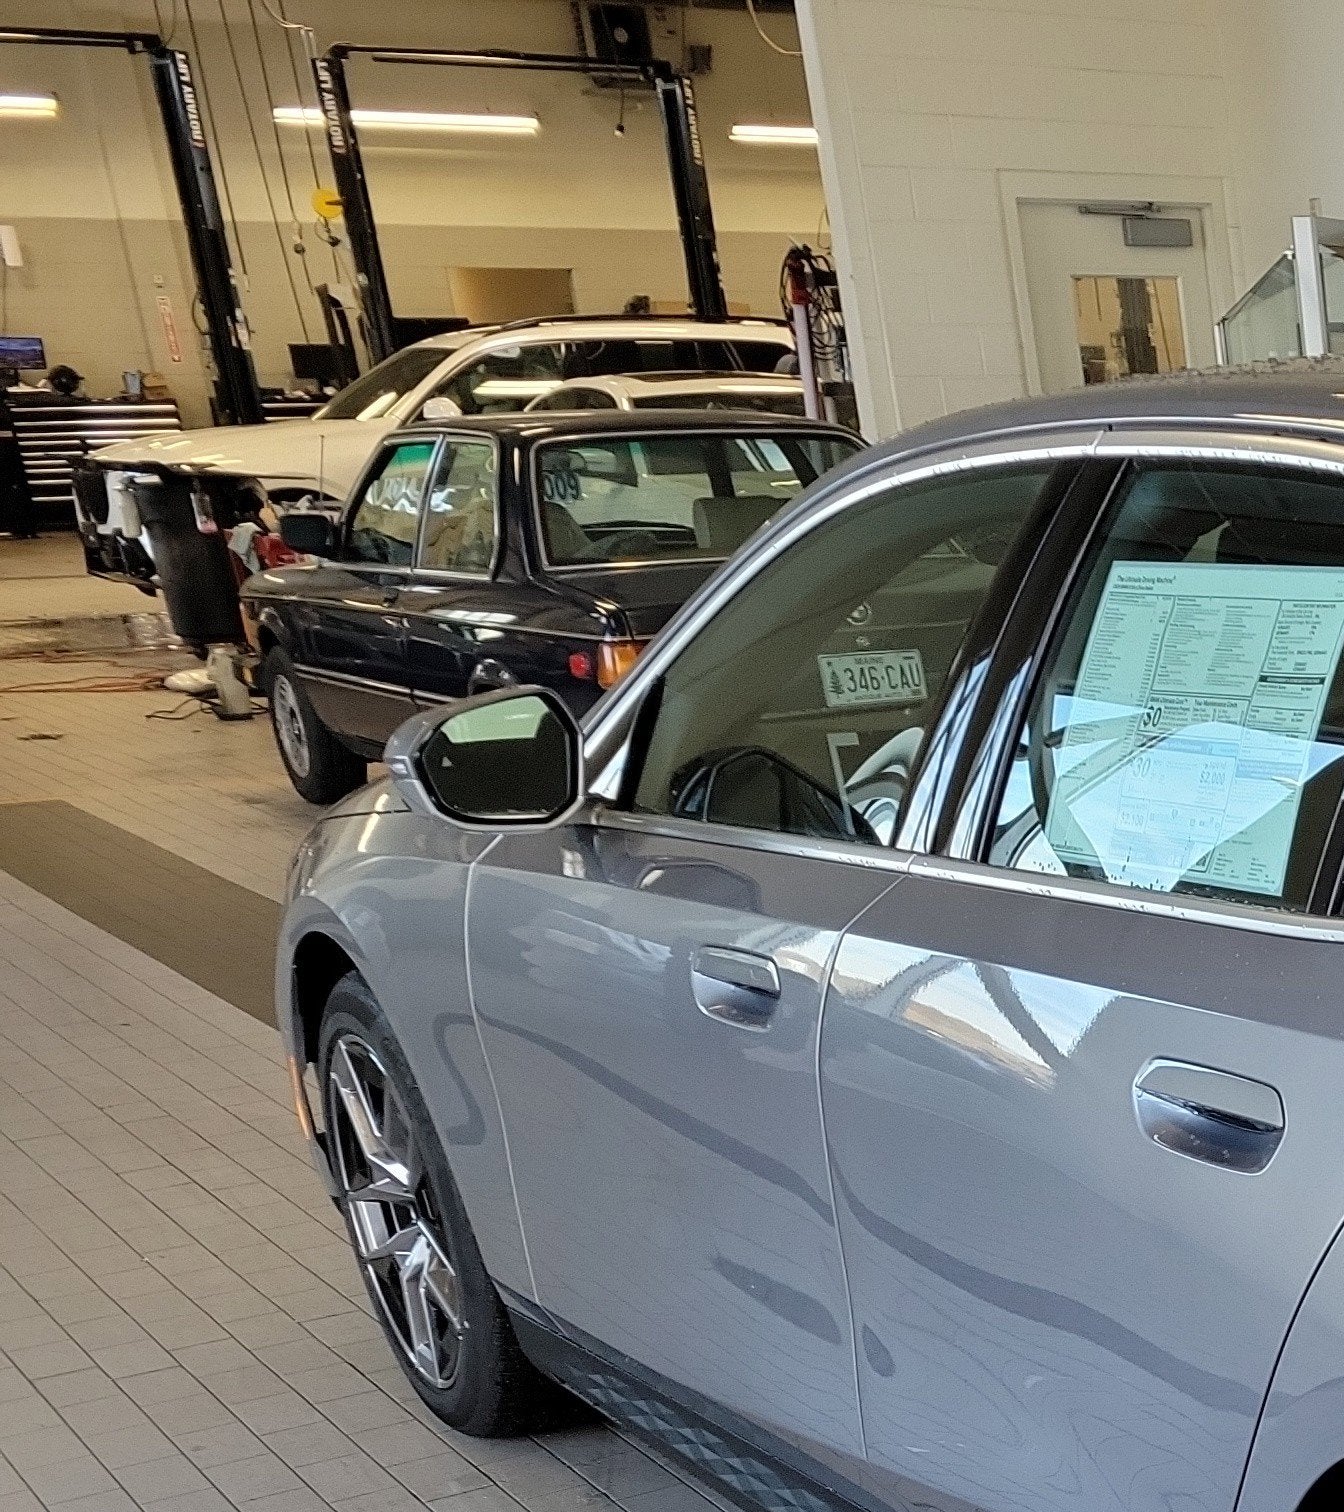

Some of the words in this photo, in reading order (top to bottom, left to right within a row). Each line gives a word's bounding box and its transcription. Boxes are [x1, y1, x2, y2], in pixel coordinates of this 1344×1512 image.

[174, 51, 191, 82] LIFT
[315, 59, 333, 88] LIFT
[181, 84, 204, 141] ROTARY
[322, 91, 346, 148] ROTARY
